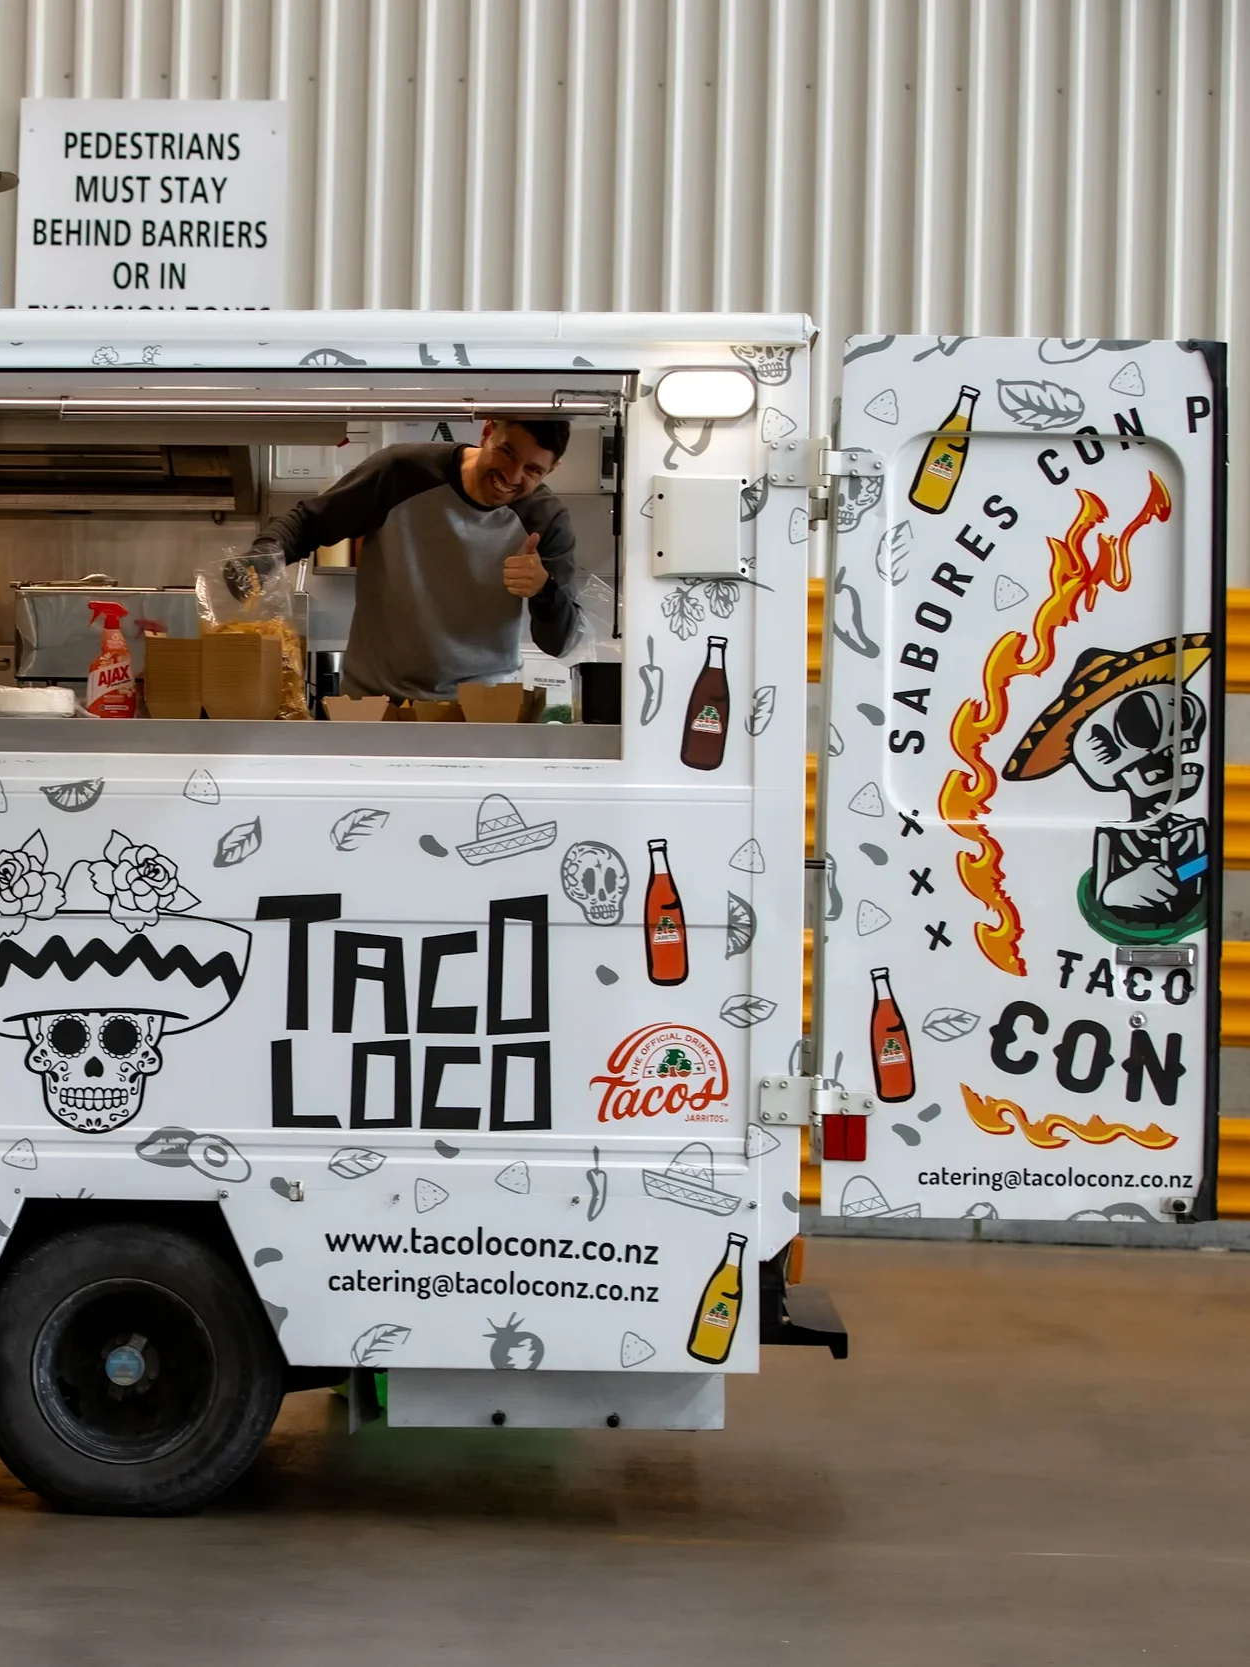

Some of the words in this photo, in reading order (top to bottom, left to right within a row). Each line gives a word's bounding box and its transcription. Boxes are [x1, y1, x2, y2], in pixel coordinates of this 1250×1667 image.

[64, 132, 240, 160] PEDESTRIANS
[75, 176, 150, 203] MUST
[160, 176, 227, 204] STAY
[33, 218, 131, 246] BEHIND
[142, 220, 268, 248] BARRIERS
[113, 262, 149, 290] OR
[160, 263, 186, 290] IN
[889, 494, 1019, 755] SABORES
[1037, 408, 1146, 486] CON
[98, 665, 130, 687] AJAX
[255, 893, 550, 1035] TACO
[1057, 949, 1194, 1005] TACO
[631, 1056, 643, 1076] THE
[642, 1033, 681, 1055] OFFICIAL
[685, 1034, 712, 1057] DRINK
[708, 1059, 717, 1073] OF
[989, 1000, 1187, 1106] CON
[271, 1039, 552, 1131] LOCO
[589, 1075, 718, 1123] Tacos
[917, 1166, 1193, 1190] catering@tacoloconz.co.nz
[325, 1226, 659, 1265] www.tacoloconz.co.nz
[328, 1269, 659, 1303] catering@tacoloconz.co.nz
